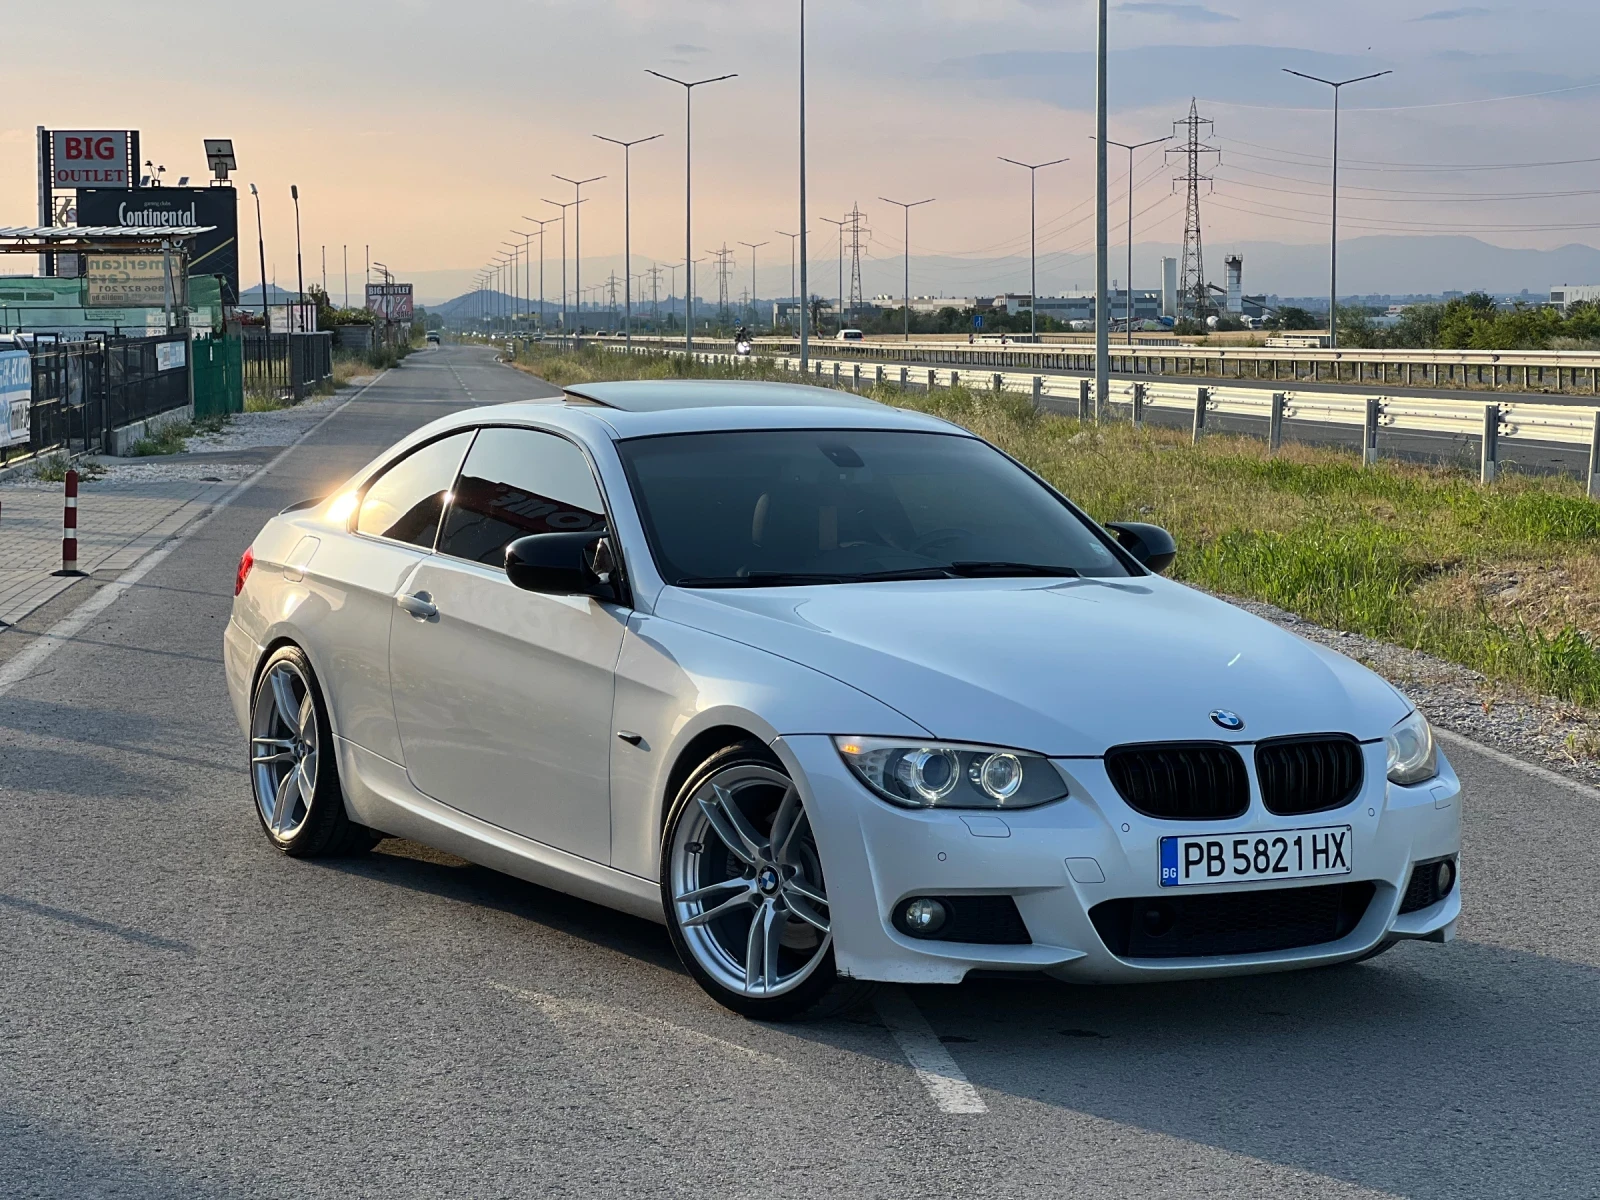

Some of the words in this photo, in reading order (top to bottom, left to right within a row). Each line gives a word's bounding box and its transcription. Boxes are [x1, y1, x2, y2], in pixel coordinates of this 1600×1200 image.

[65, 137, 115, 160] BIG
[57, 169, 125, 182] OUTLET
[119, 201, 197, 226] Continental
[369, 286, 382, 294] BIG
[1184, 841, 1226, 879] PB
[1232, 835, 1303, 875] 5821
[1312, 831, 1347, 870] HX
[1162, 867, 1177, 879] BG
